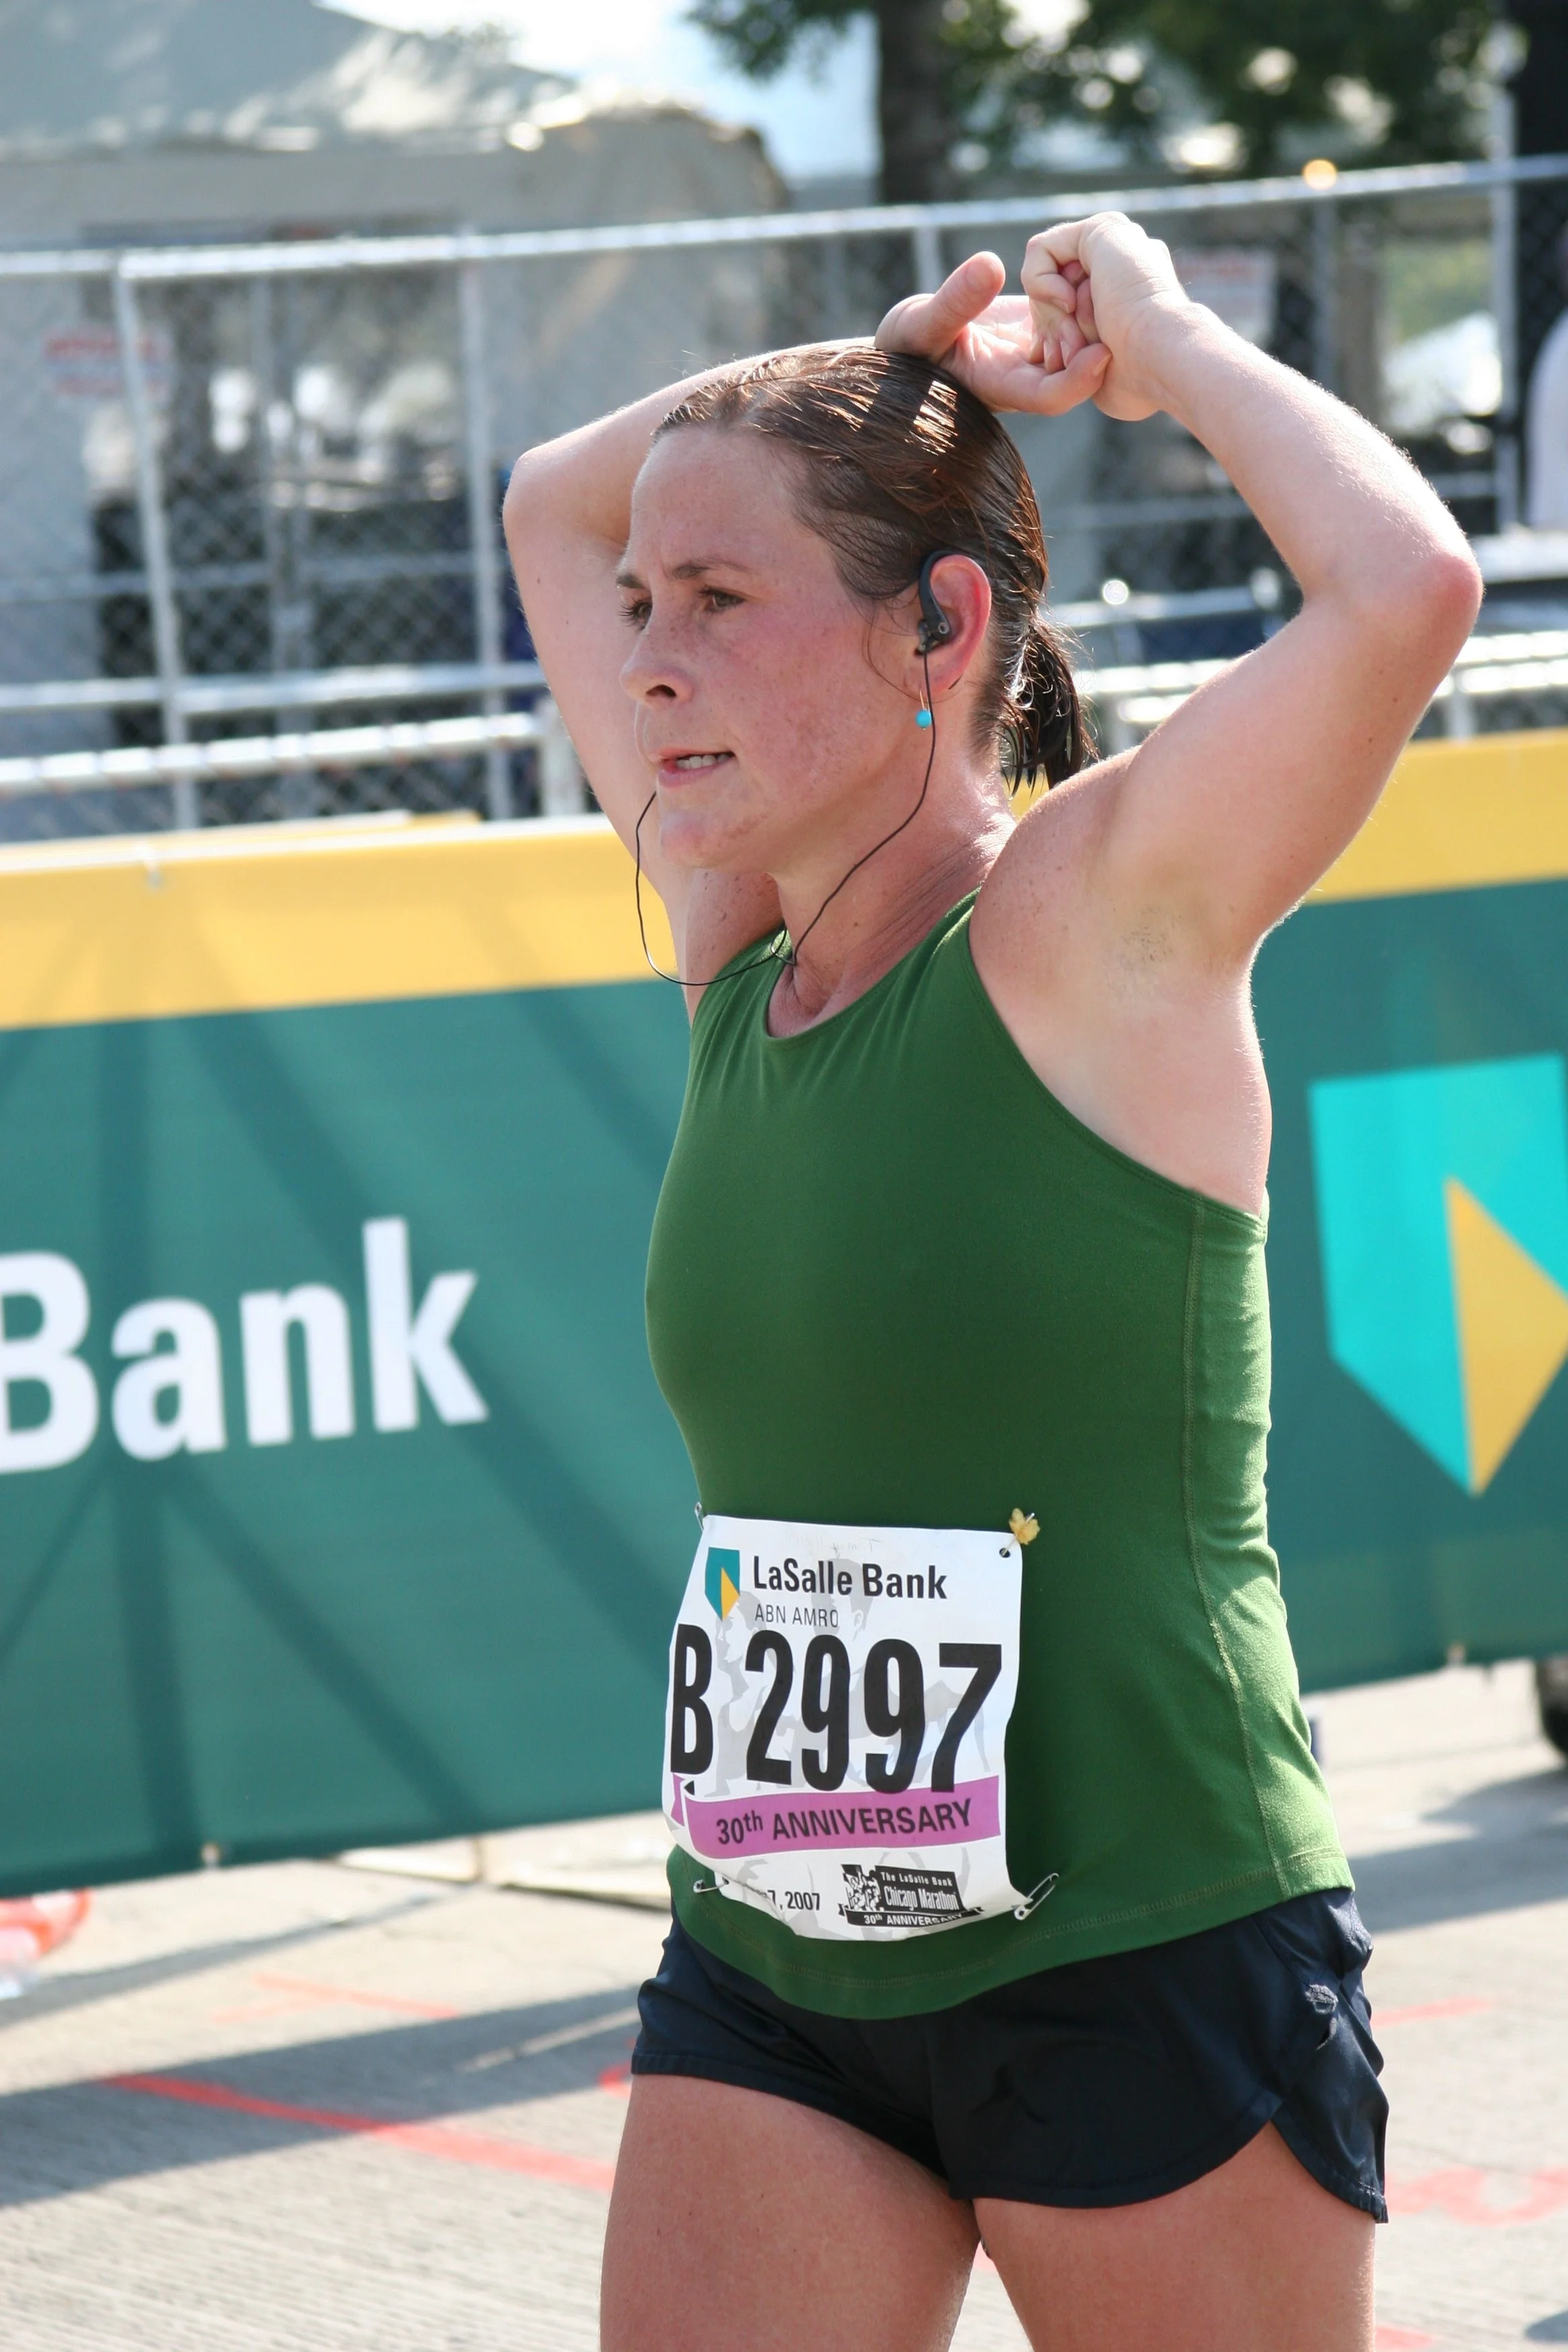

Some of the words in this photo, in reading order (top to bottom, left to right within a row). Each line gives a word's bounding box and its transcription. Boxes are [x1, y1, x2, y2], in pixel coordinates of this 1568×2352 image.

[0, 1216, 489, 1473] Bank
[753, 1555, 852, 1596] LaSalle
[862, 1563, 948, 1600] Bank
[755, 1604, 786, 1624] ABN
[792, 1606, 838, 1628] AMRO
[671, 1624, 714, 1775] B
[745, 1630, 1002, 1794] 2997
[716, 1810, 763, 1845] 30th
[773, 1798, 971, 1841] ANNIVERSARY
[881, 1871, 895, 1882] The
[899, 1873, 930, 1885] LaSalle
[931, 1876, 953, 1887] Bank
[785, 1891, 820, 1911] 2007
[883, 1885, 918, 1911] Chicago
[863, 1913, 883, 1925] 30th
